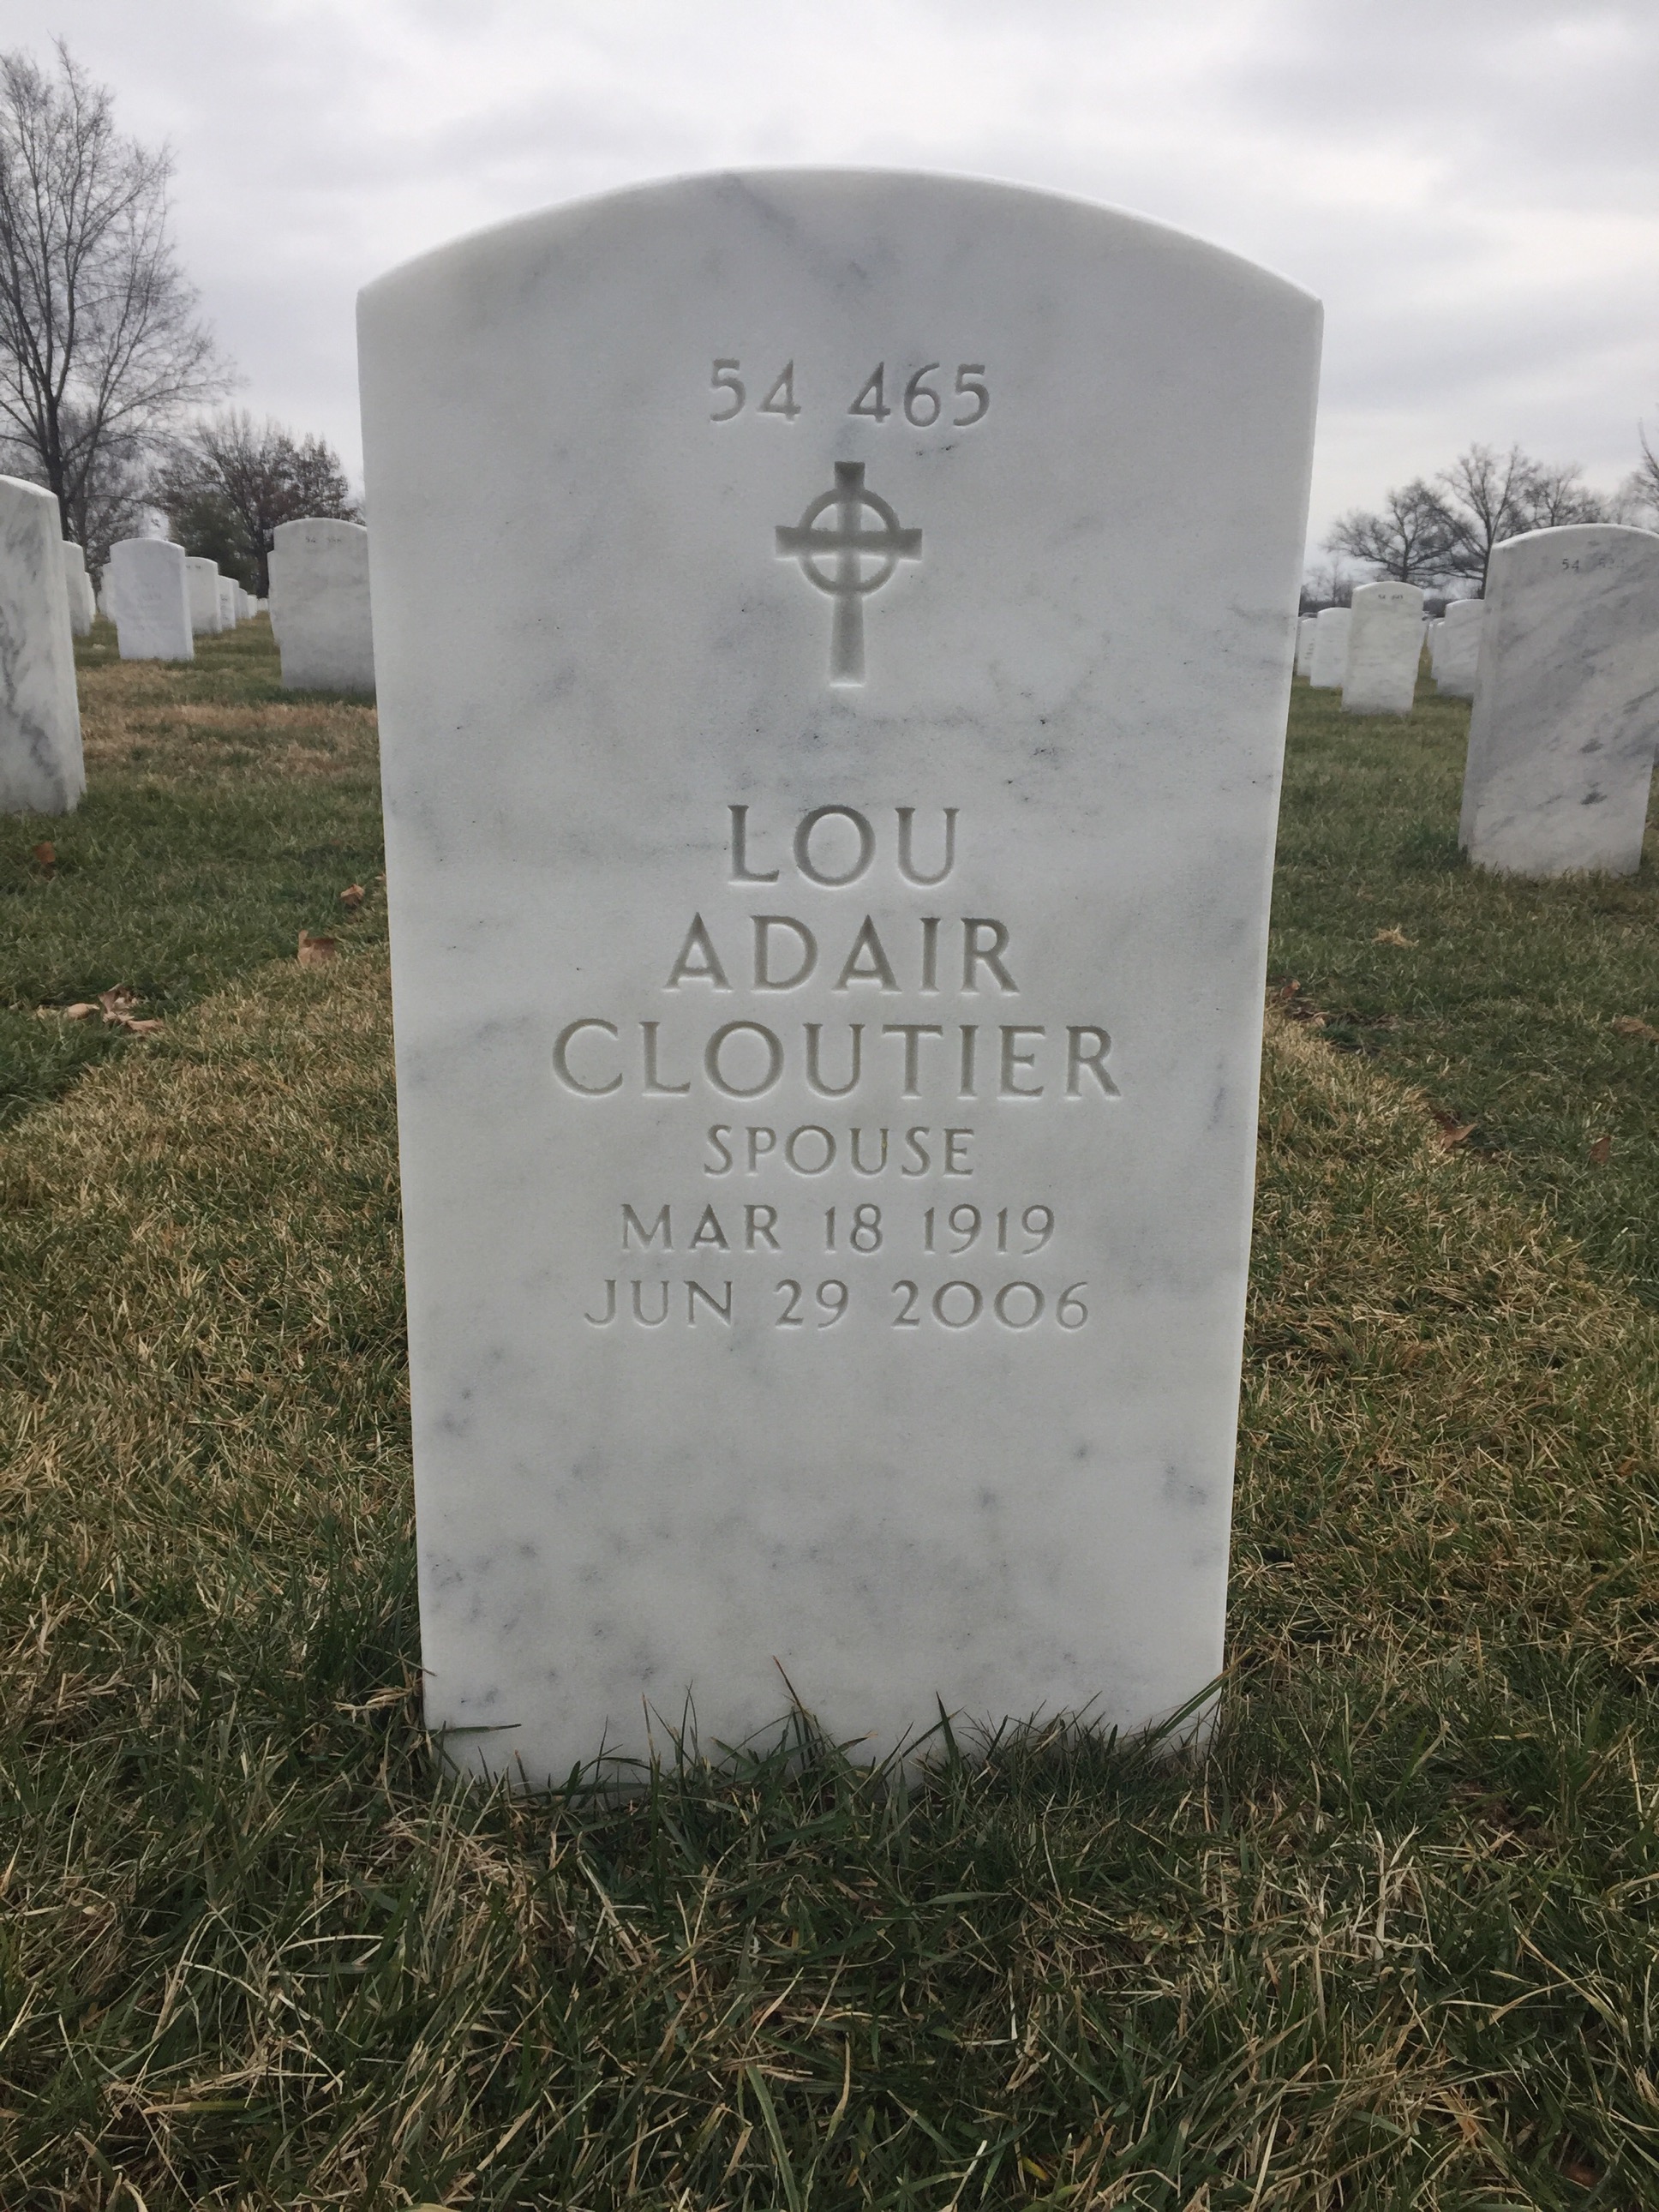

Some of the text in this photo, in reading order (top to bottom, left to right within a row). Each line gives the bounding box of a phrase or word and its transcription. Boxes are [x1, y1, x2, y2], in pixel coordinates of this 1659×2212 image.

[709, 357, 991, 428] 54 465
[1561, 558, 1580, 572] 54
[728, 804, 960, 888] LOU
[661, 911, 1021, 994] ADAIR
[551, 1017, 1122, 1101] CLOUTIER
[702, 1124, 975, 1178] SPOUSE
[620, 1203, 1056, 1256] MAR 18 1919
[584, 1279, 1090, 1331] JUN 29 2006
